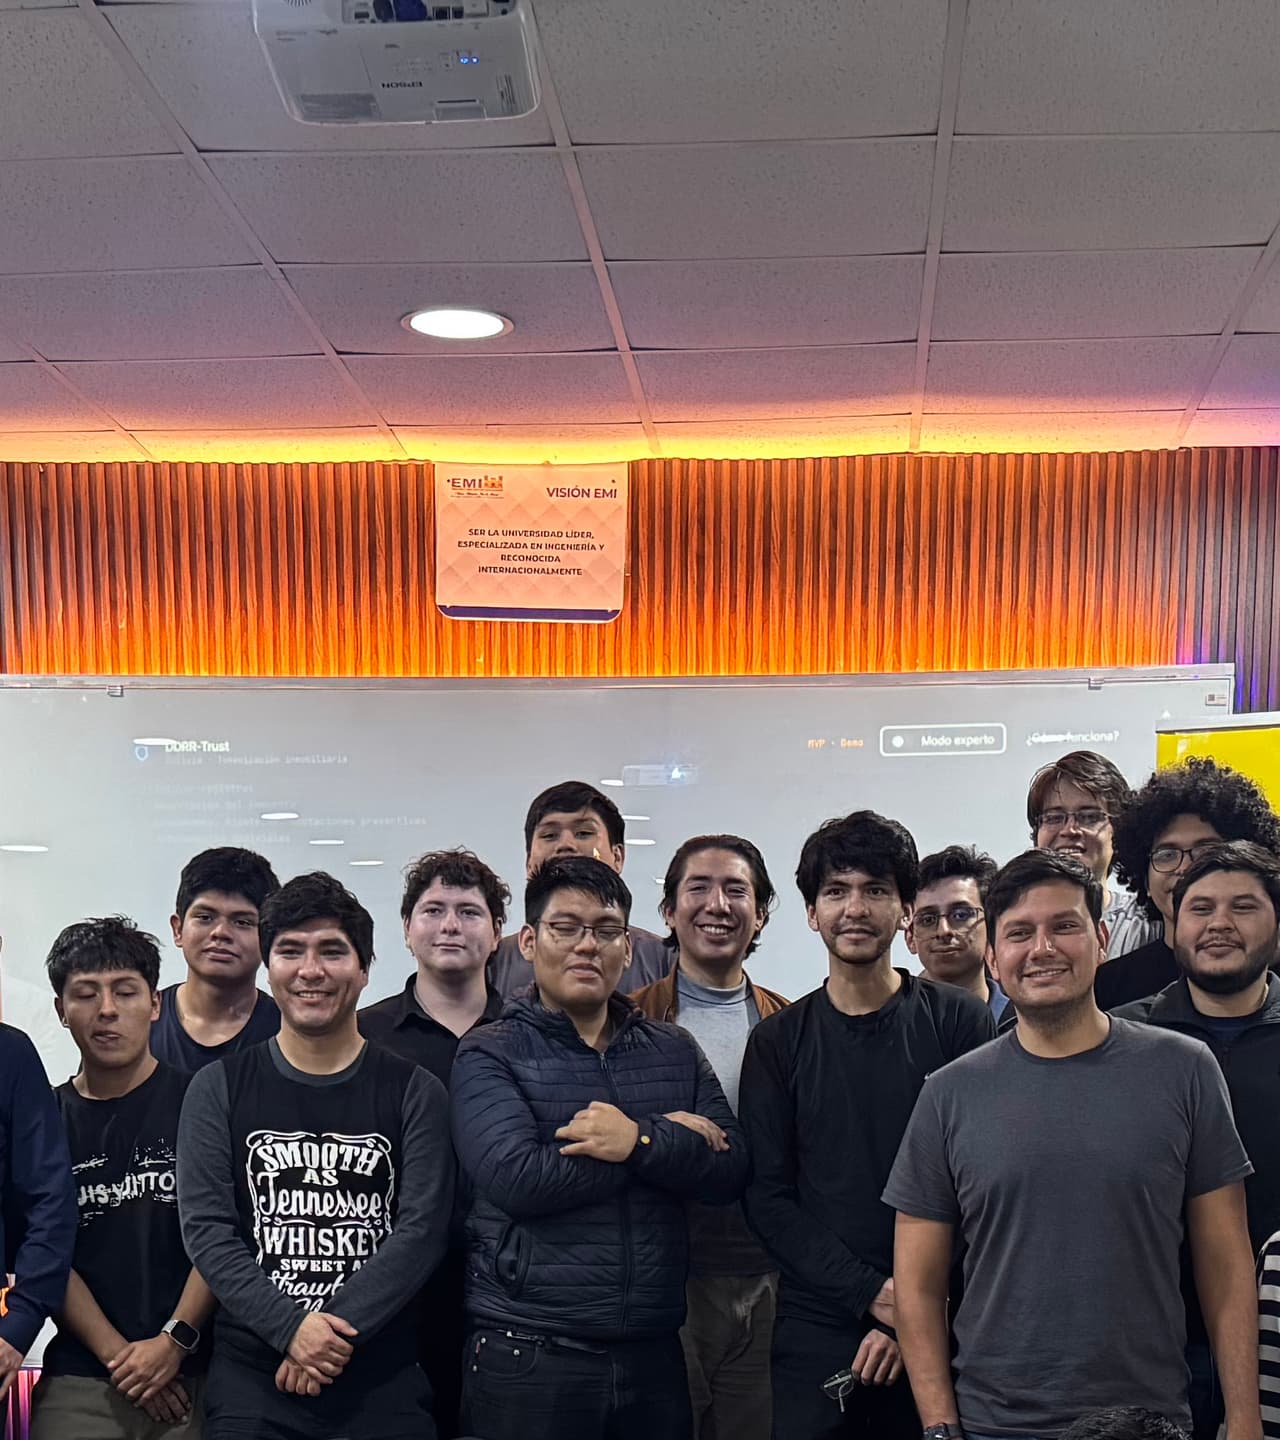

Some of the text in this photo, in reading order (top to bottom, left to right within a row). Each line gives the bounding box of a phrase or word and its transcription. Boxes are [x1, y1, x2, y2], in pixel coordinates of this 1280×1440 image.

[451, 478, 483, 488] EMI
[546, 485, 618, 498] VISIÓN EMI
[468, 529, 595, 539] SER LA UNIVERSIDAD LÍDER,
[457, 541, 529, 550] ESPECIALIZADA
[530, 542, 543, 550] EN
[545, 542, 597, 551] INGENIERÍA
[500, 554, 561, 563] RECONOCIDA
[478, 566, 583, 576] INTERNACIONALMENTE
[165, 740, 230, 753] DDRR-Trust
[921, 734, 996, 748] Modo experto
[256, 1141, 384, 1177] SMOOTH
[302, 1168, 339, 1186] AS
[257, 1171, 382, 1219] Tennessee
[263, 1226, 384, 1256] WHISKEY
[280, 1258, 368, 1272] SWEET A
